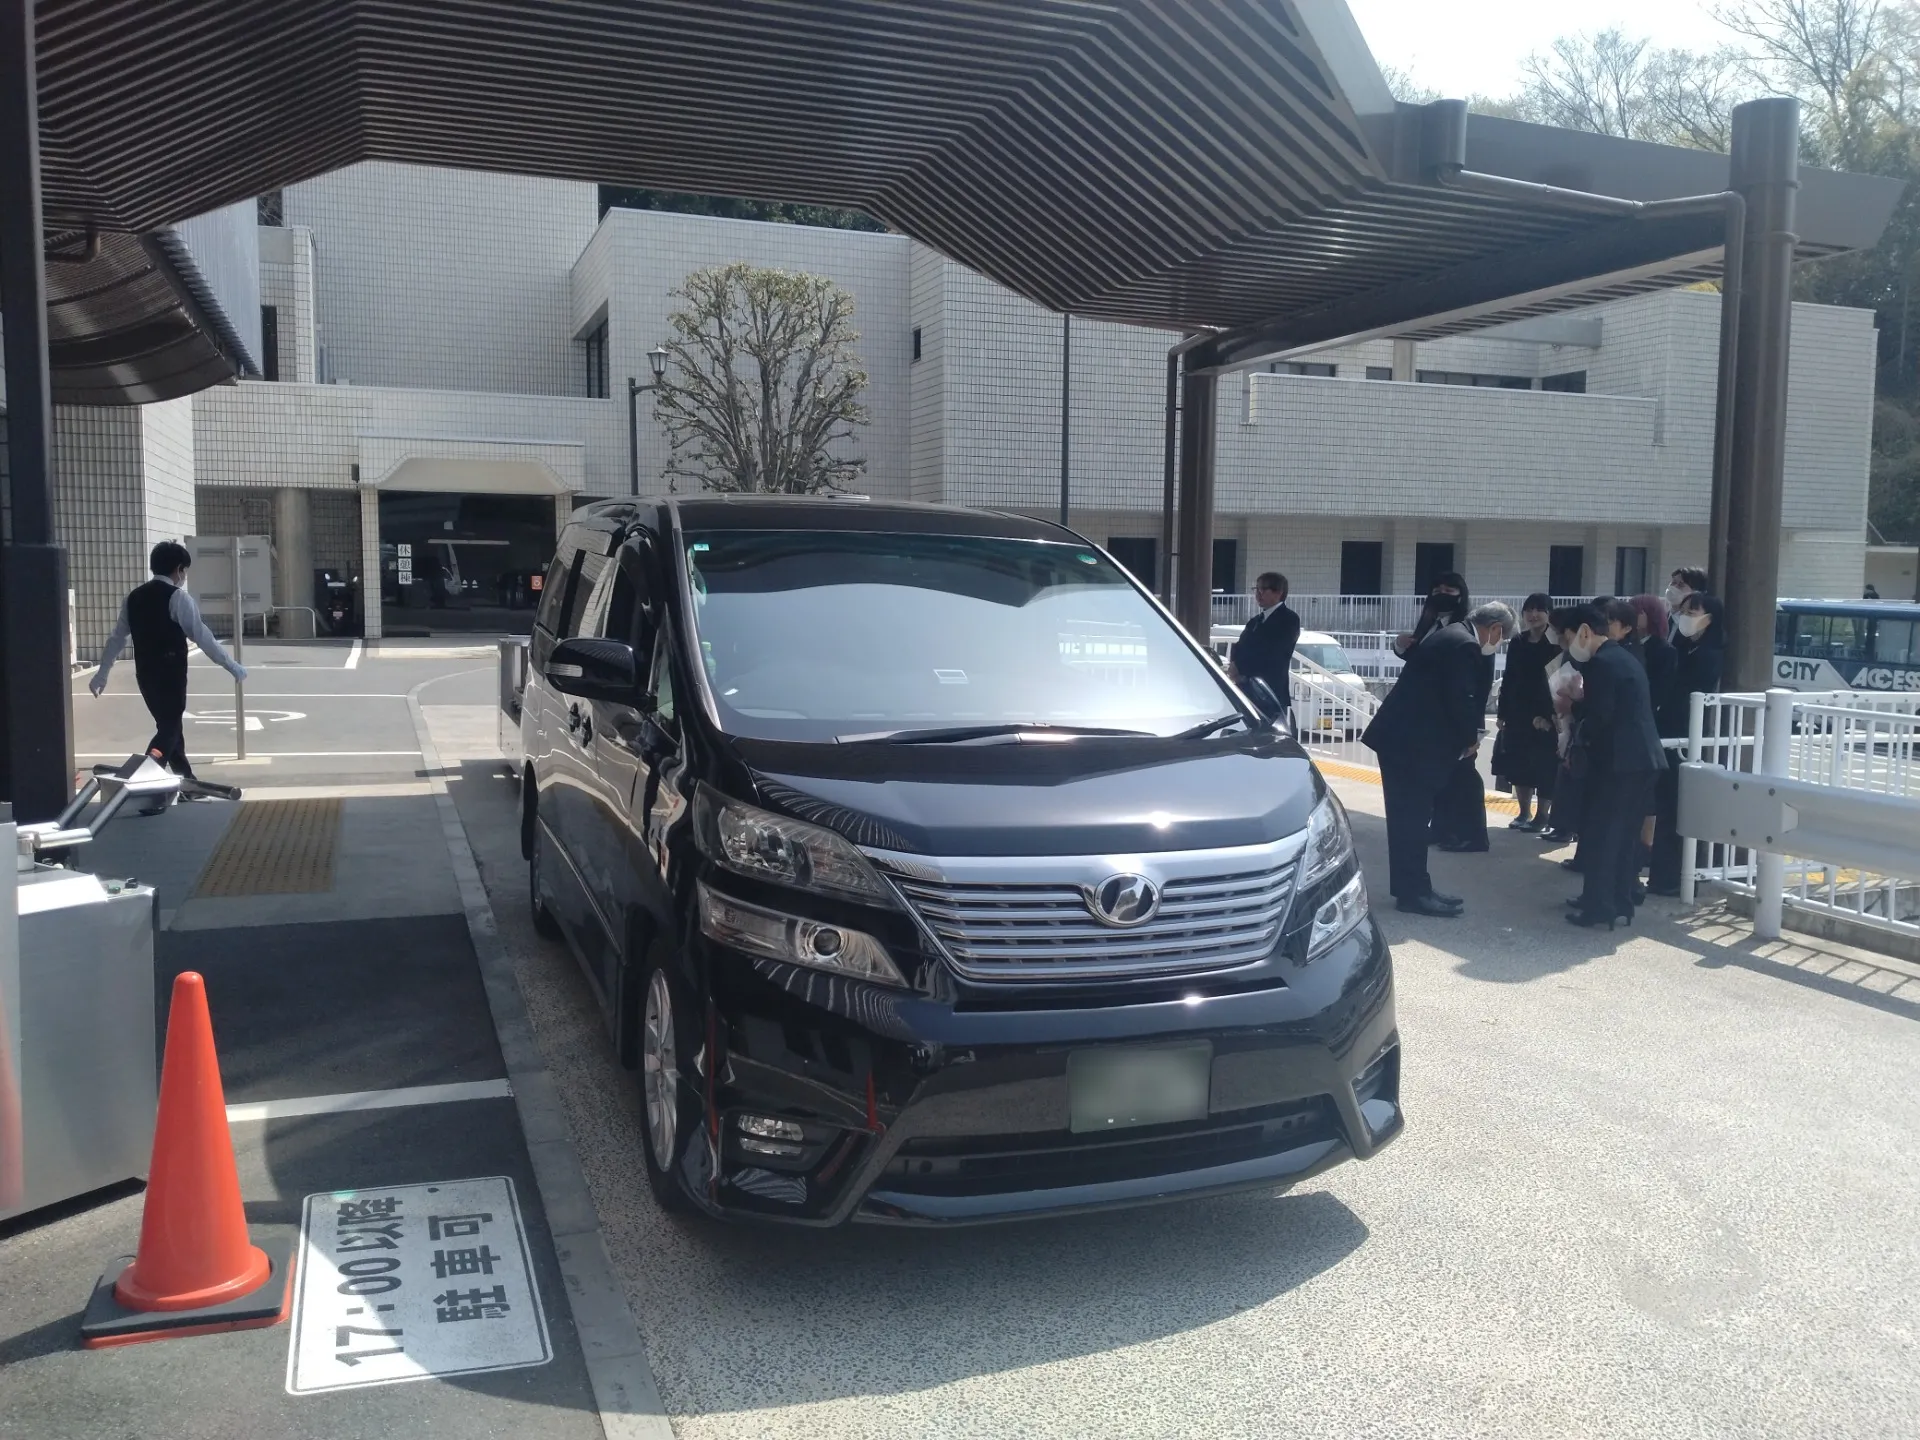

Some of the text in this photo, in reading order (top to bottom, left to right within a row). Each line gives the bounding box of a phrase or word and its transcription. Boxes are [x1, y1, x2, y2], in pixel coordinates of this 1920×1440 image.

[398, 544, 412, 584] 休憩棟
[1777, 660, 1821, 681] CITY
[428, 1212, 511, 1323] 駐車可
